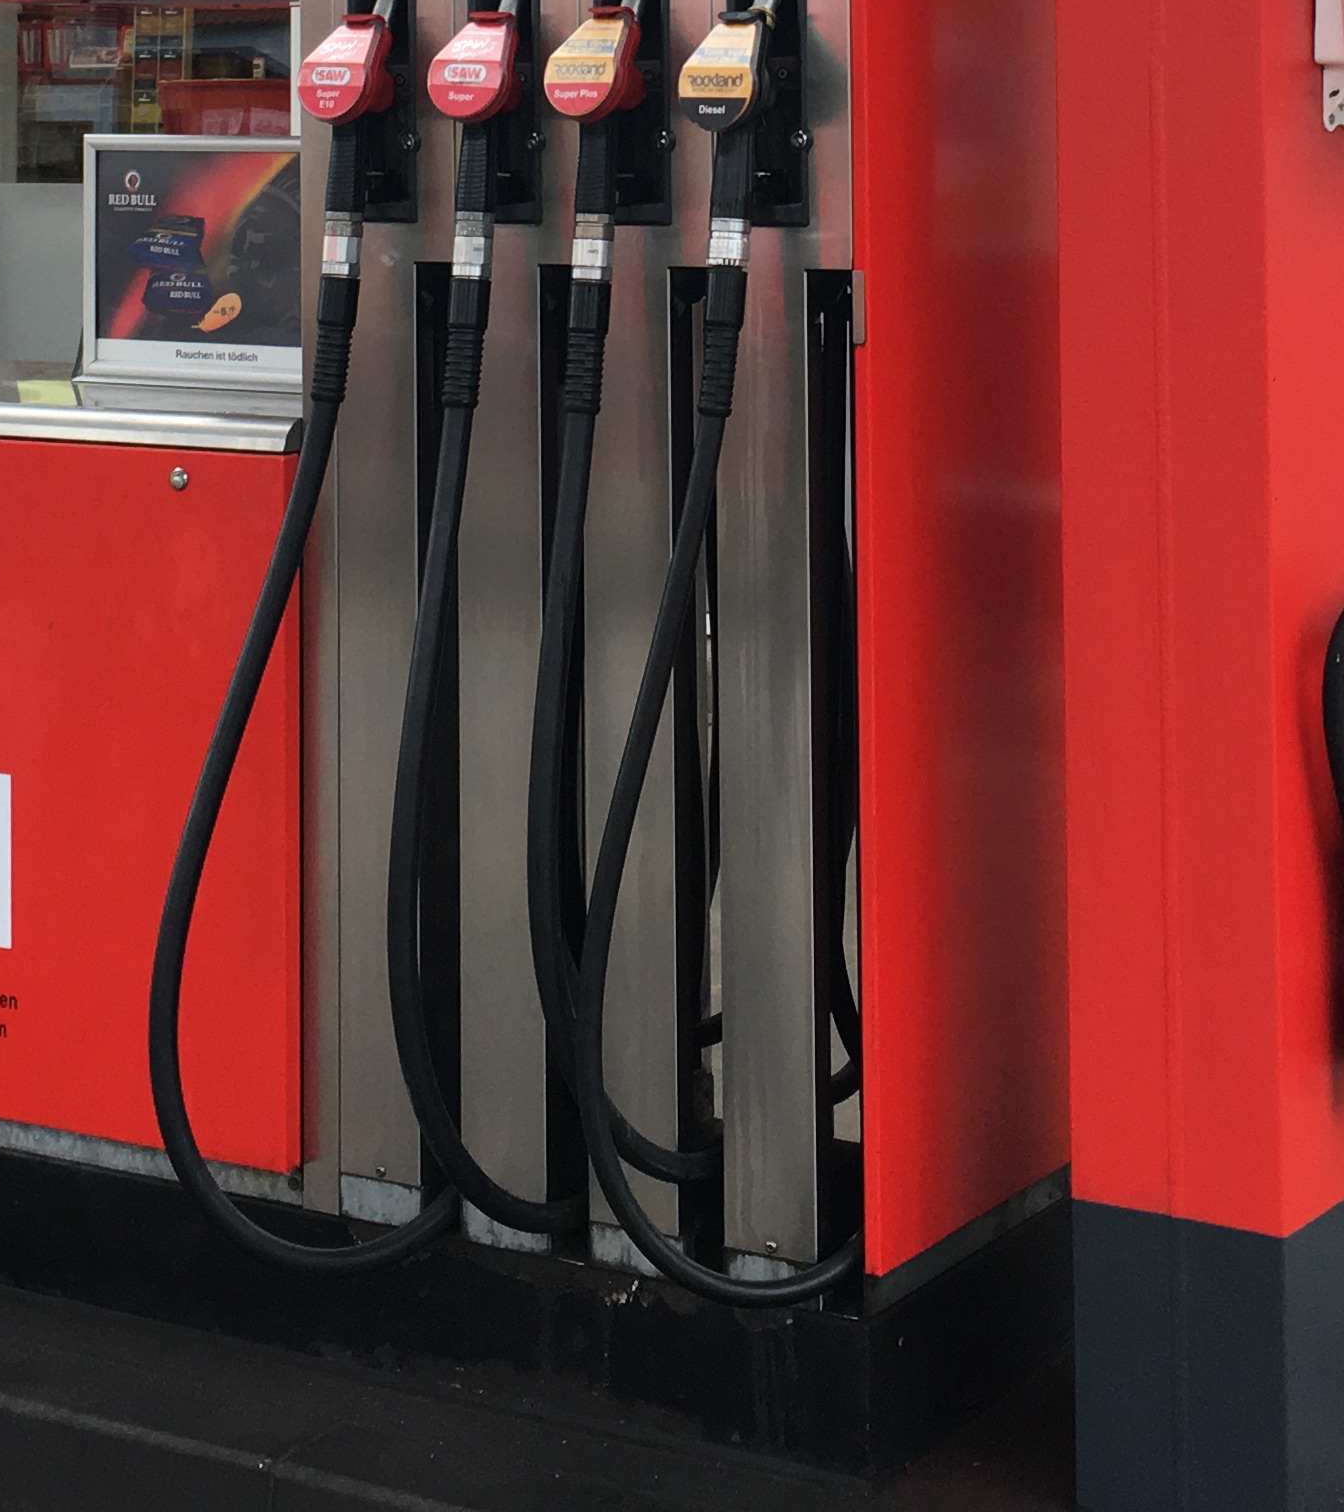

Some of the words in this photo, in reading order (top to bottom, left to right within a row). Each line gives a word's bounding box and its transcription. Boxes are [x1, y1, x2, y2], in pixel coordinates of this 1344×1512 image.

[316, 89, 340, 99] Super
[448, 91, 474, 102] Super
[554, 90, 578, 100] Super
[579, 90, 598, 99] Plus
[319, 99, 335, 109] E10
[699, 104, 726, 115] Diesel
[108, 193, 129, 206] RED
[131, 193, 157, 206] BULL
[175, 349, 214, 361] Rauchen
[215, 350, 226, 361] ist
[228, 350, 258, 362] tödlich
